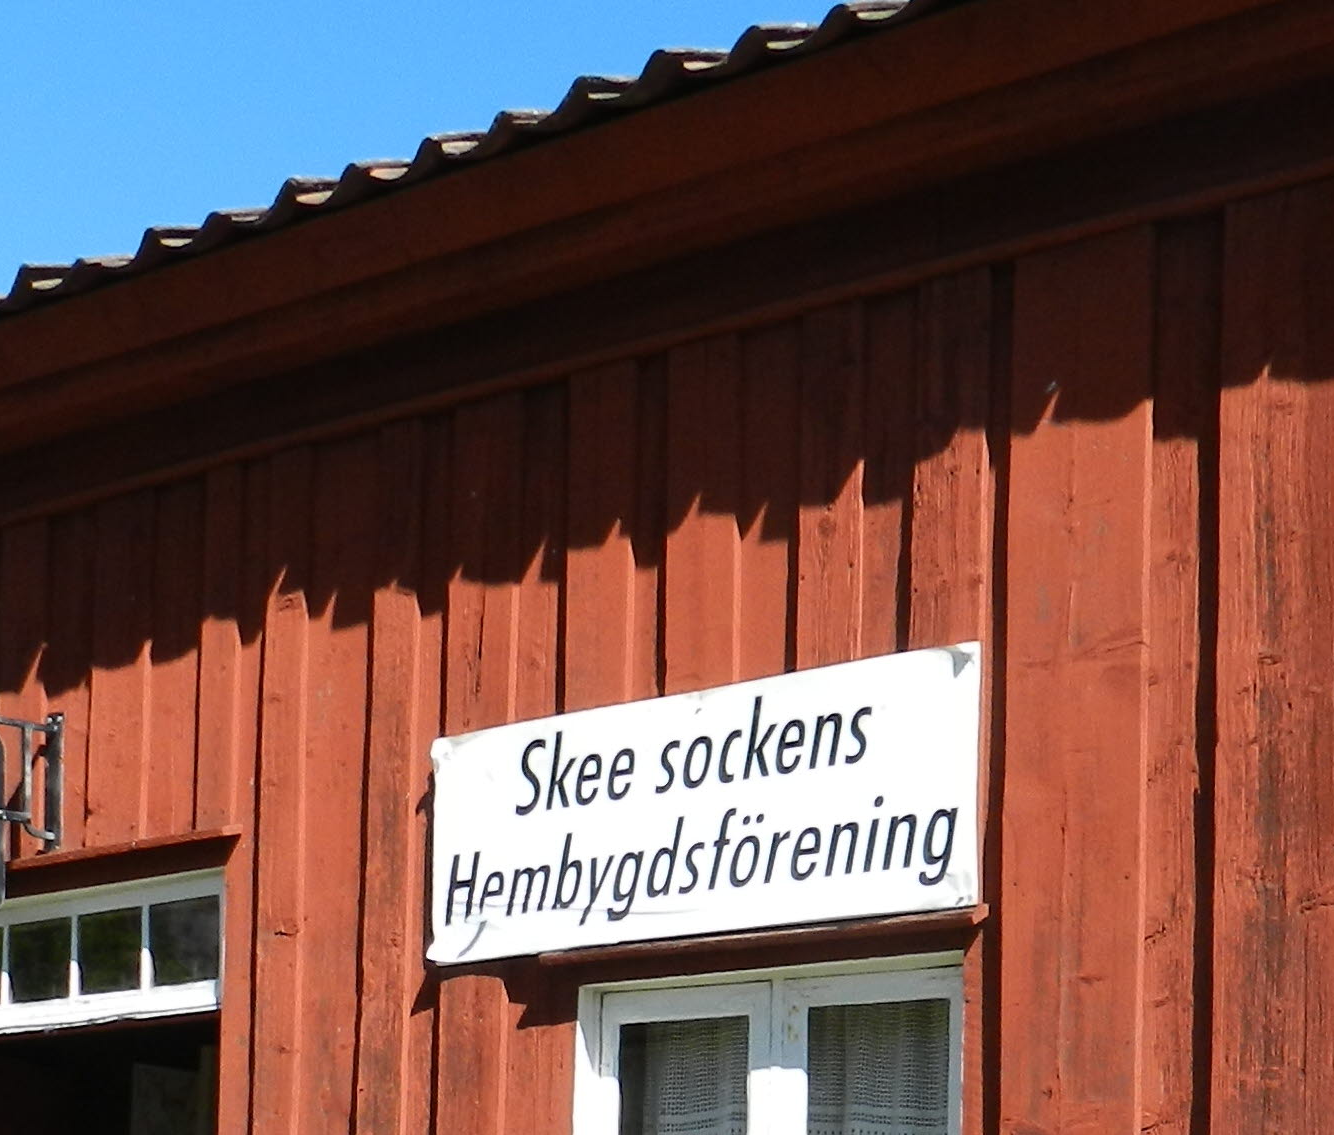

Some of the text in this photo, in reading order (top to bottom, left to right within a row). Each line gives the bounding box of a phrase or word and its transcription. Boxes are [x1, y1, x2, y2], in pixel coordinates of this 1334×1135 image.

[515, 695, 873, 816] Skee sockens
[444, 795, 959, 927] Hembygdsförening
